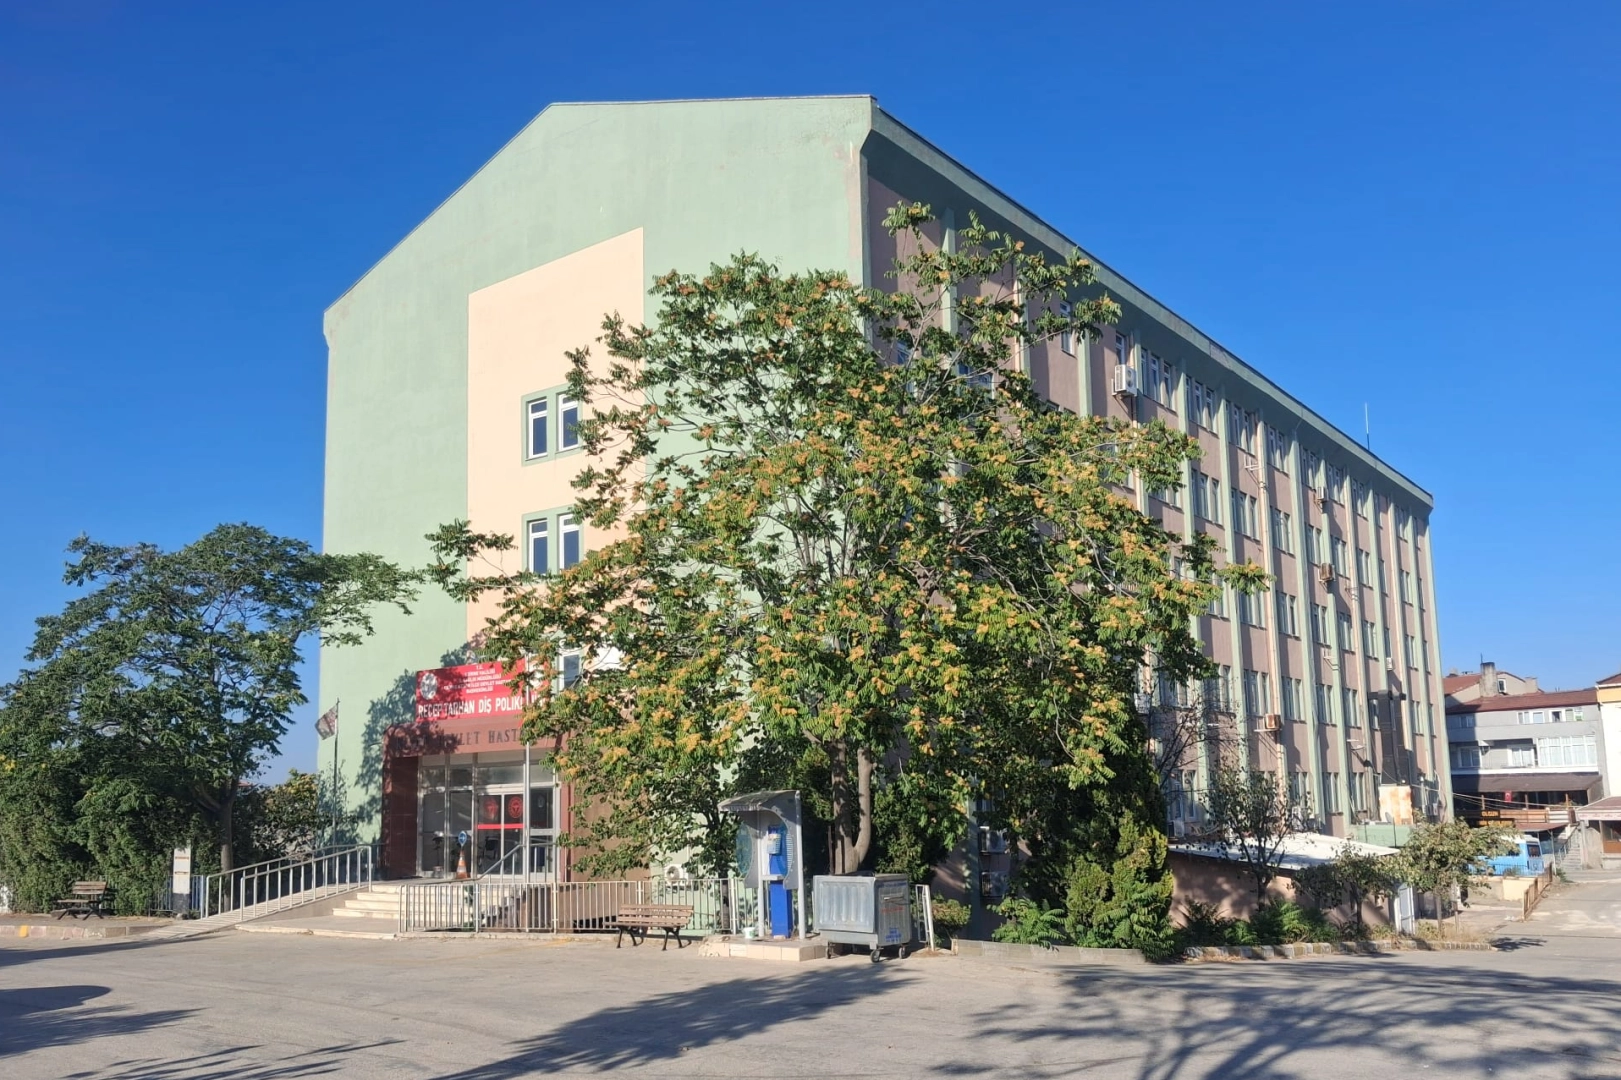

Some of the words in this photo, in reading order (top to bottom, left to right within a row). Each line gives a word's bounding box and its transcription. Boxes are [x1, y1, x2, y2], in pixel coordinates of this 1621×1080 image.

[418, 703, 443, 718] RECEP
[444, 700, 475, 715] TARHAN
[478, 696, 492, 713] DİŞ
